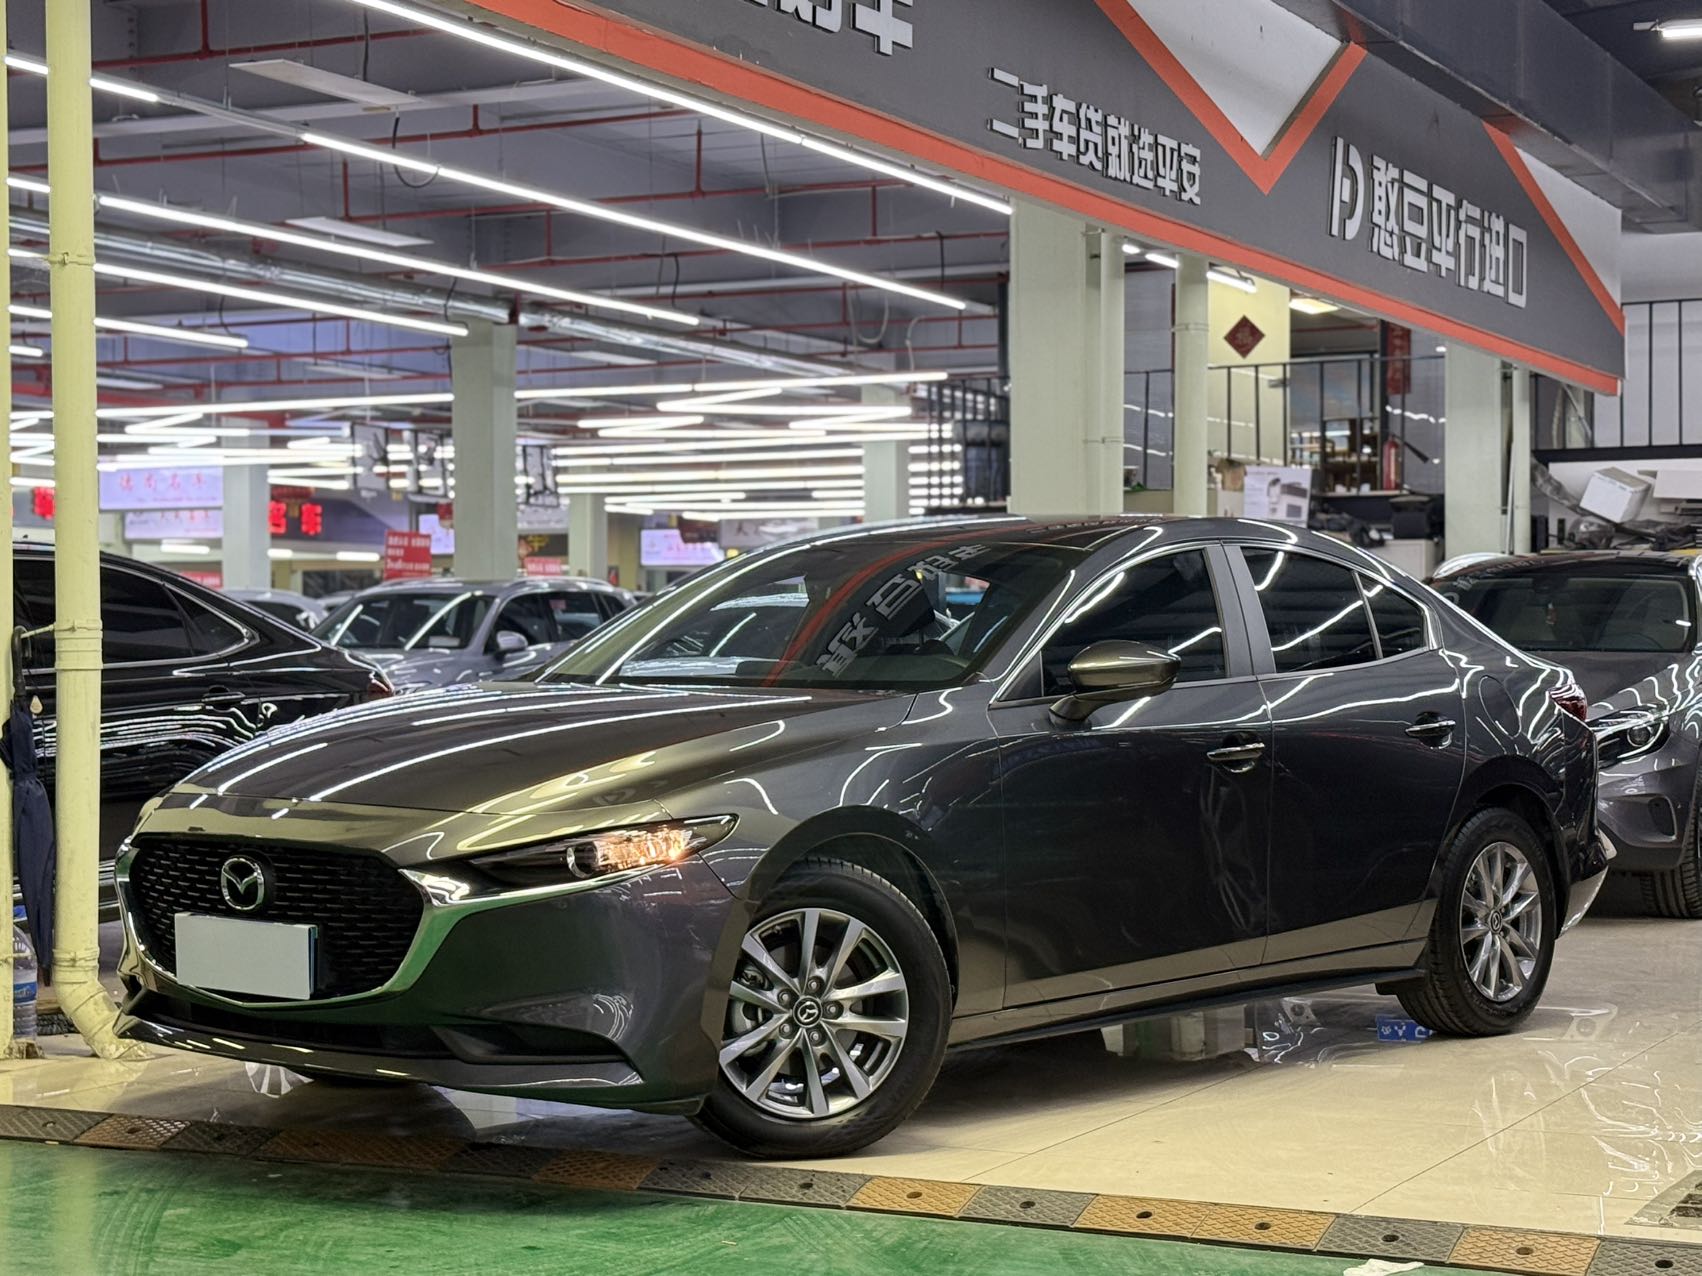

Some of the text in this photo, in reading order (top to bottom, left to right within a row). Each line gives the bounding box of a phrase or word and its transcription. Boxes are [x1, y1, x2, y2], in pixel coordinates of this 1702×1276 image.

[989, 67, 1201, 205] 二手车贷就选平安
[1370, 154, 1527, 308] 憨豆平行进口
